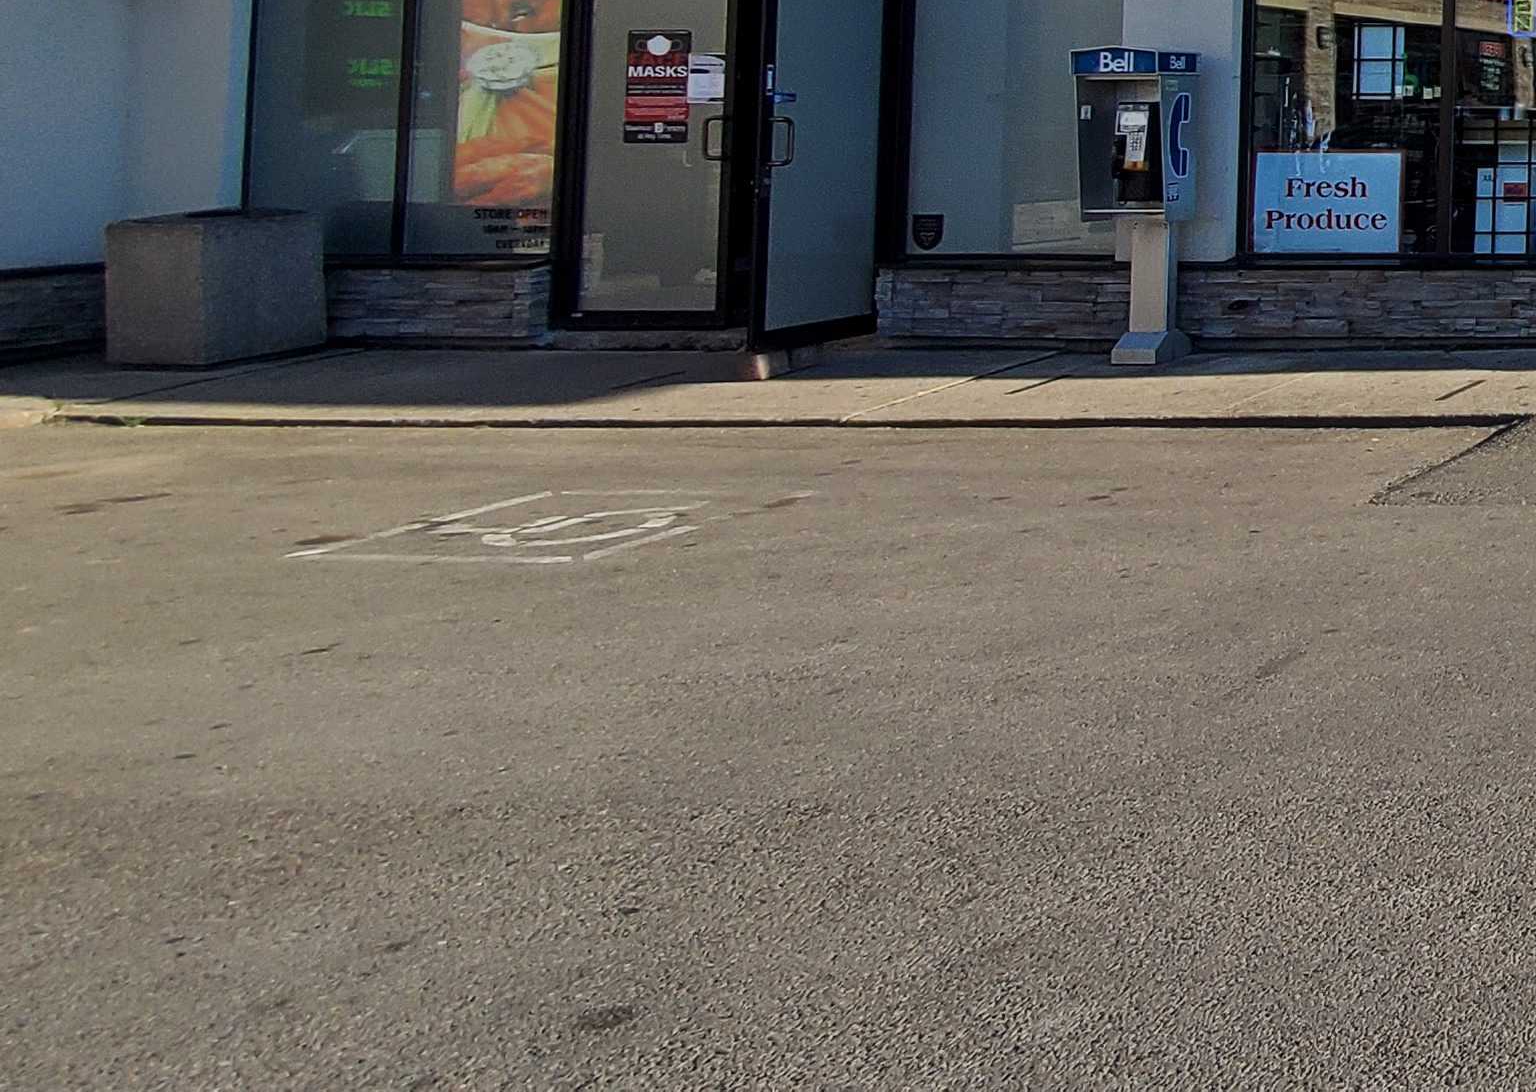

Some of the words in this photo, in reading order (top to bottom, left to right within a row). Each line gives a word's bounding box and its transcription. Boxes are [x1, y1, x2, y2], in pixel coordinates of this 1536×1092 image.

[627, 66, 688, 78] MASKS
[1099, 51, 1134, 73] Bell
[1169, 55, 1186, 70] Bell
[1285, 176, 1368, 199] Fresh
[1265, 208, 1388, 230] Produce
